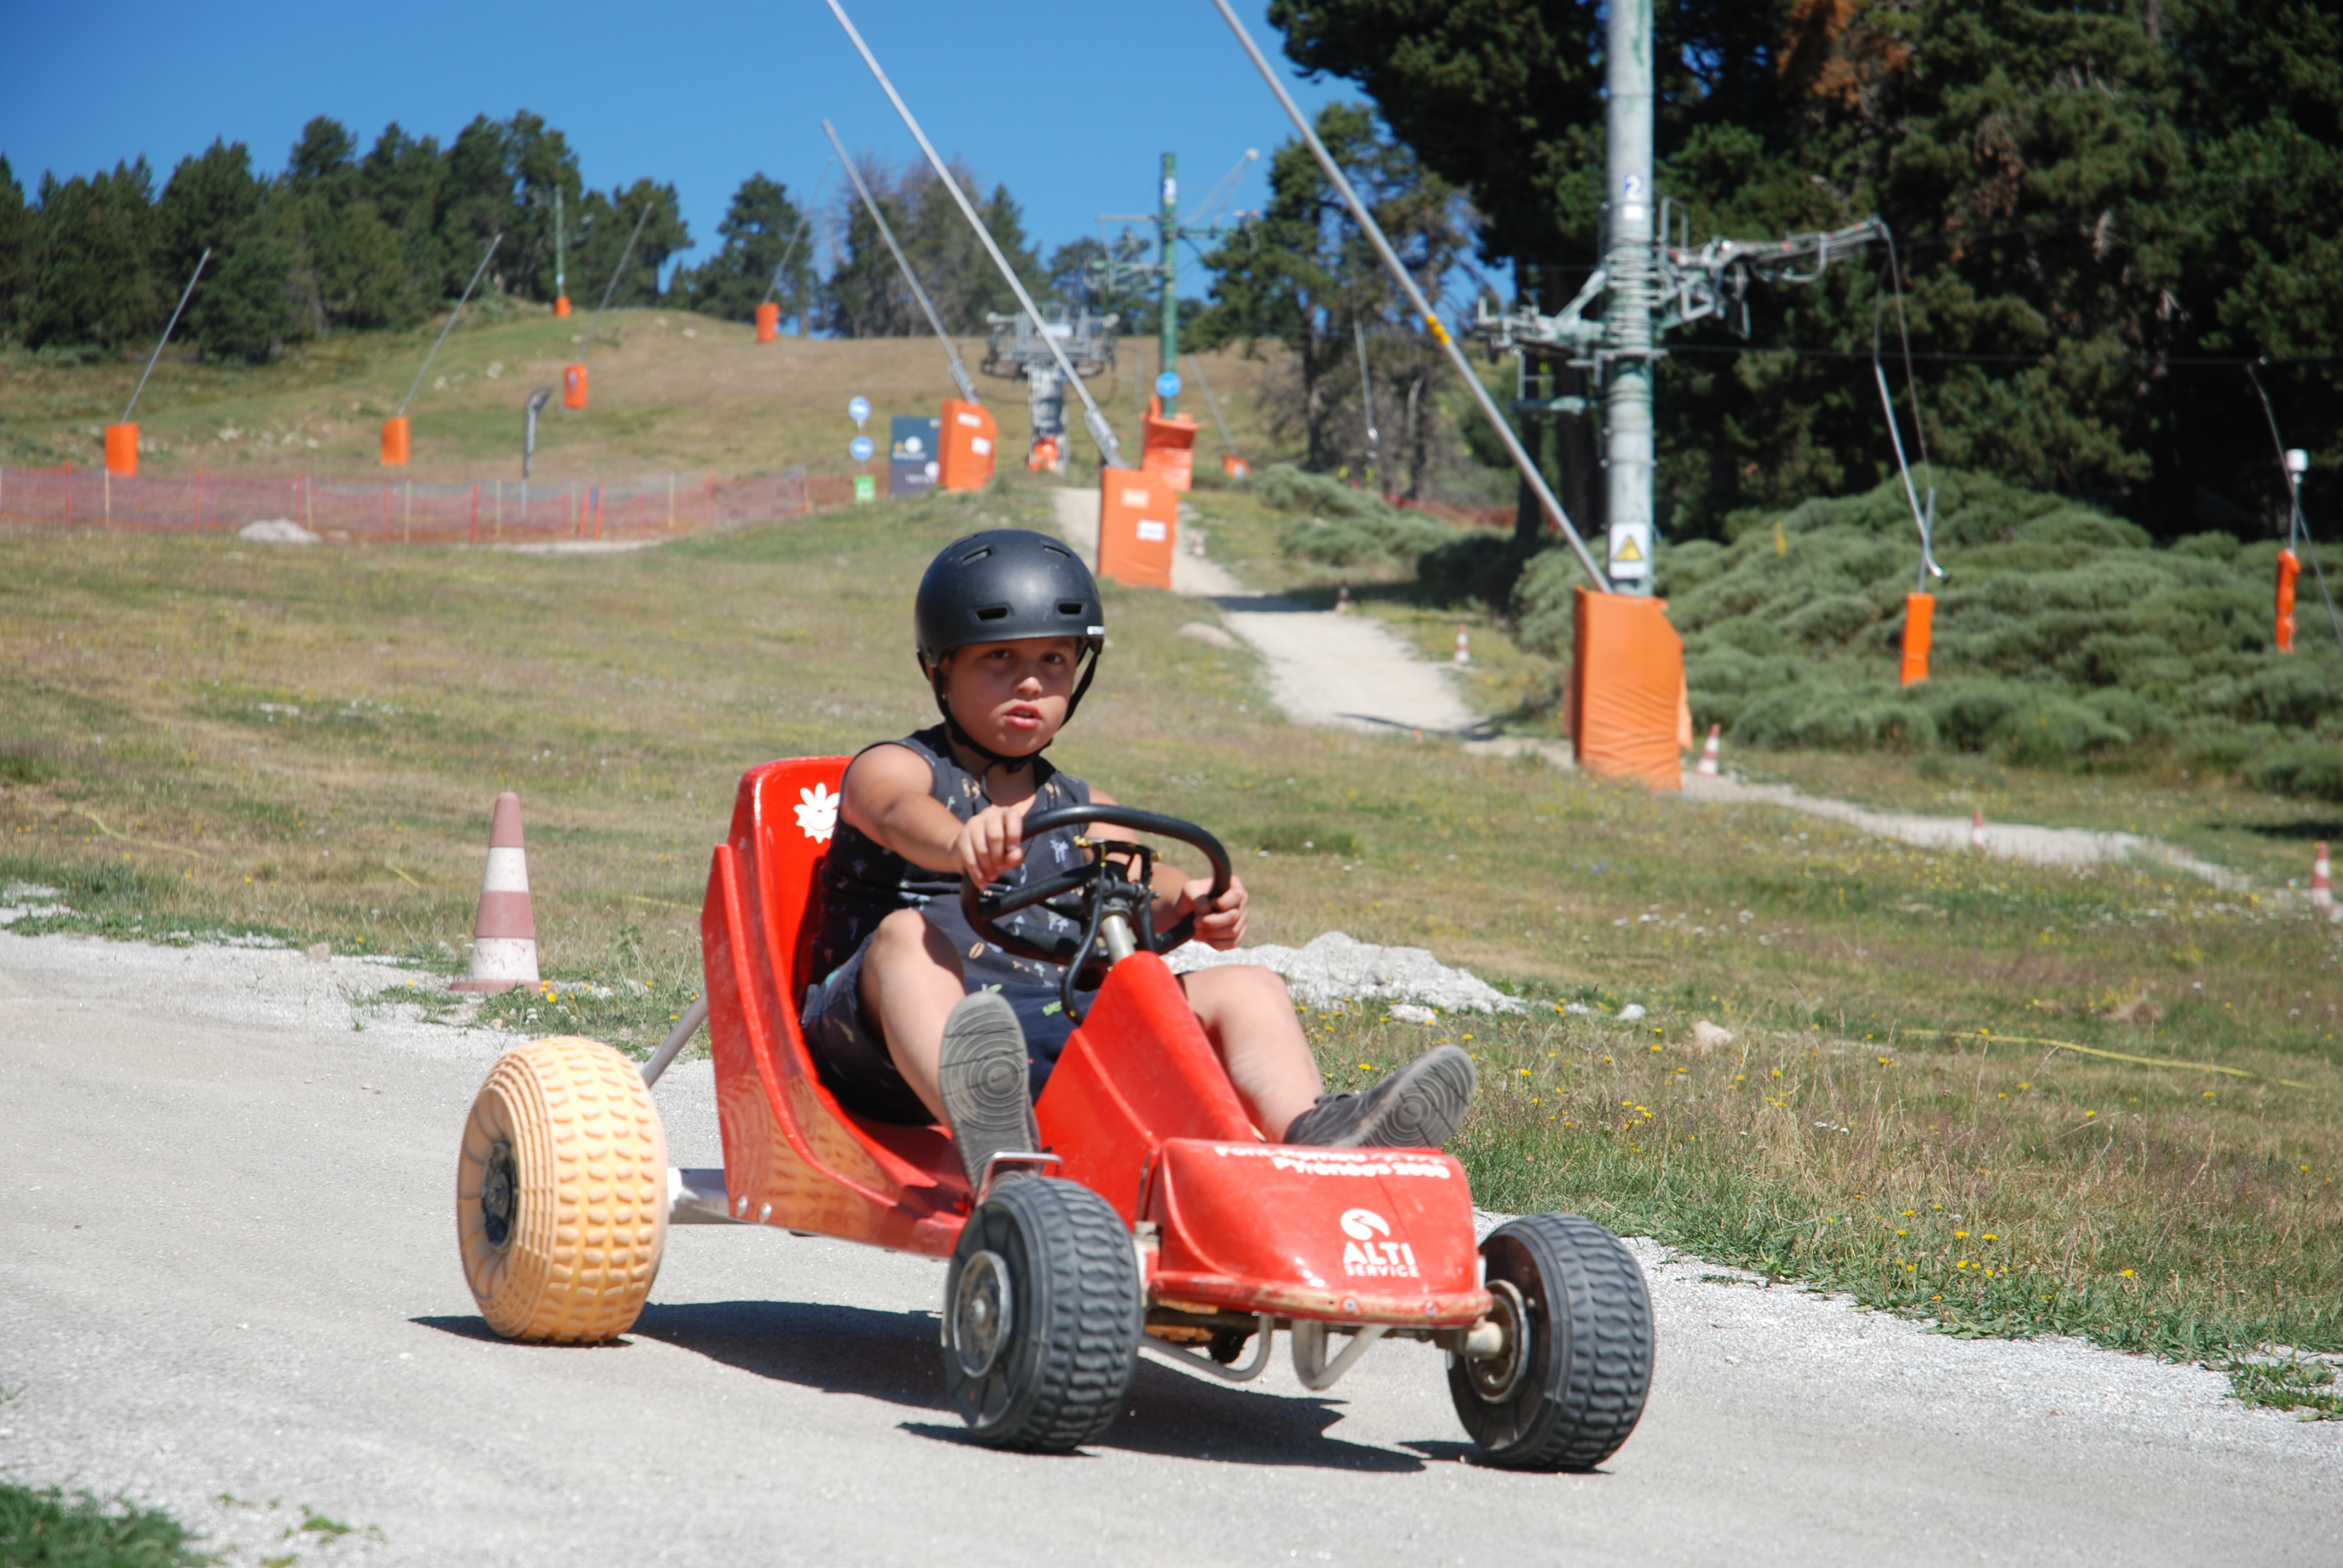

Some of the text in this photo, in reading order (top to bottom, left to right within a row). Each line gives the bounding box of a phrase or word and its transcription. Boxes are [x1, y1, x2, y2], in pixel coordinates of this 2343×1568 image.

[1624, 175, 1642, 201] 2
[1391, 1161, 1450, 1179] 2000
[1343, 1241, 1415, 1265] ALTI
[1344, 1264, 1420, 1277] SERVICE
